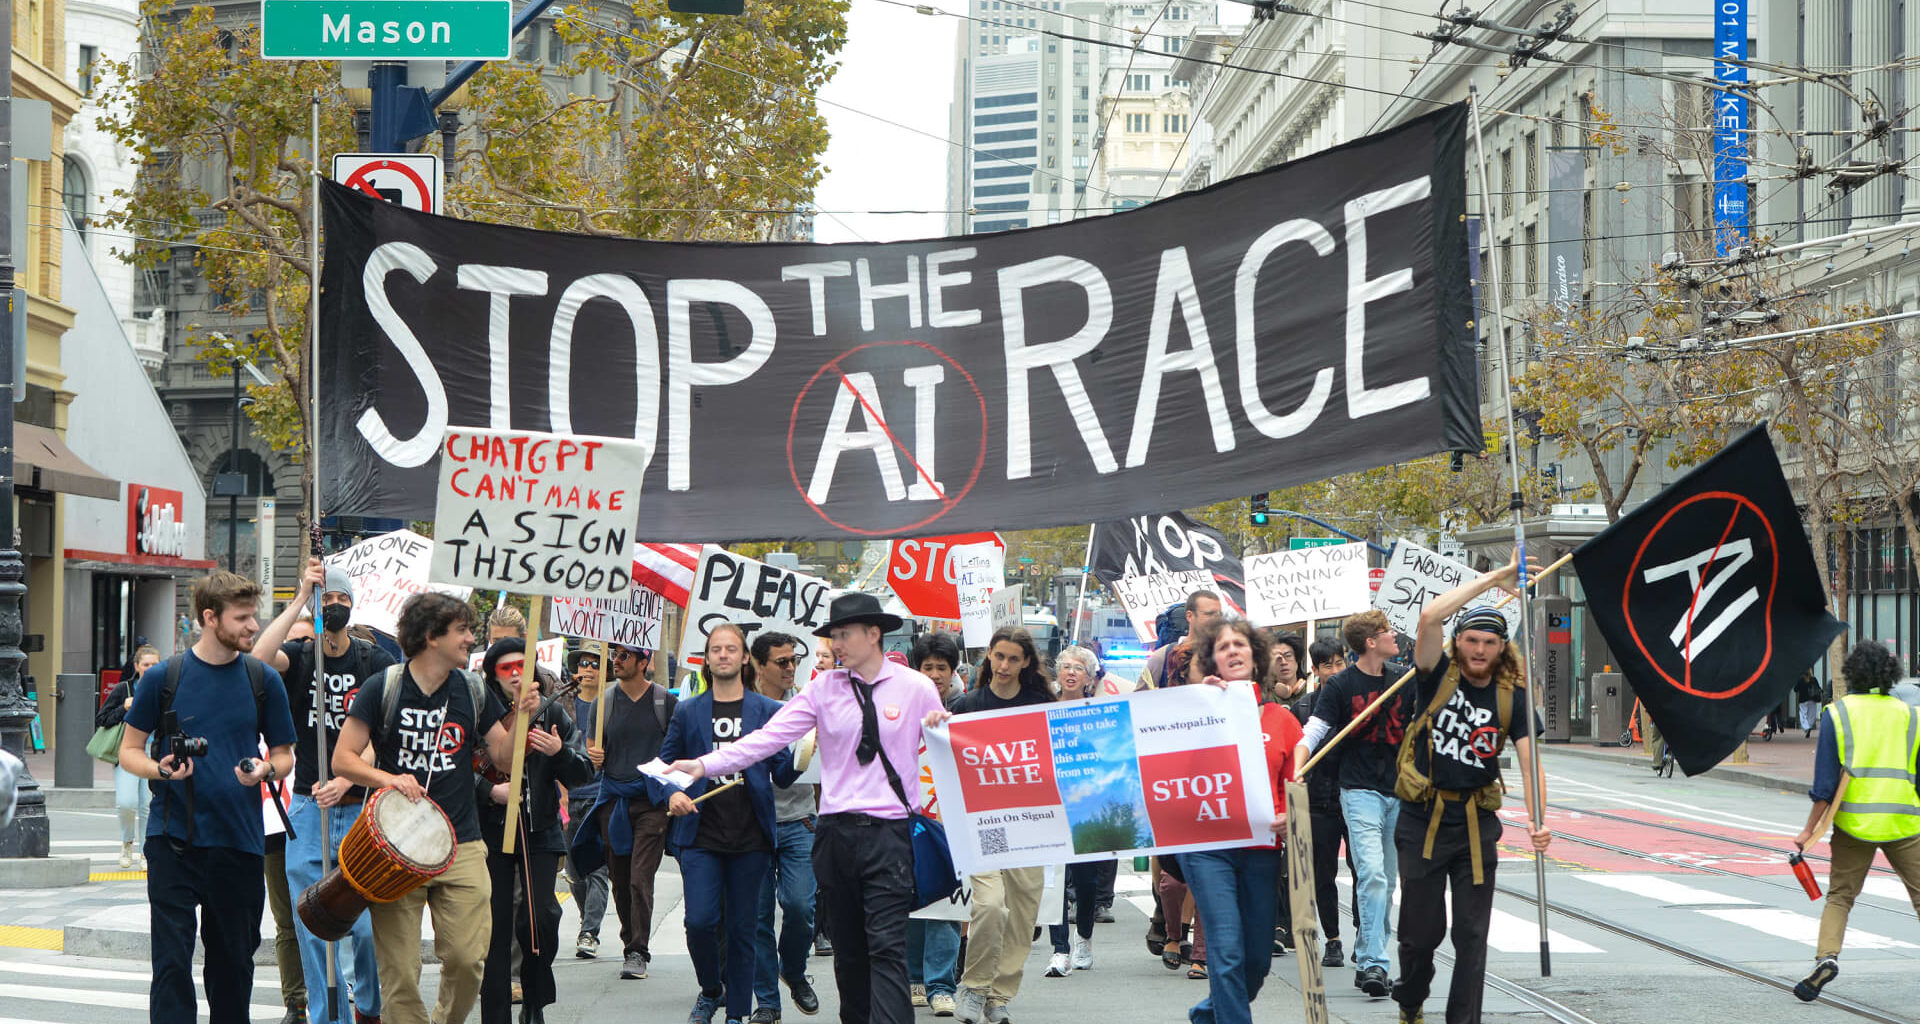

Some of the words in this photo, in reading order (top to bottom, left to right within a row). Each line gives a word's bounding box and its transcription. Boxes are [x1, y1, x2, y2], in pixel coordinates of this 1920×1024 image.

[322, 13, 451, 44] Mason
[356, 241, 776, 492] STOP
[782, 247, 983, 336] THE
[997, 175, 1432, 480] RACE
[806, 365, 944, 505] AI
[446, 433, 603, 474] CHATGPT
[450, 468, 540, 503] CAN'T
[544, 485, 625, 511] MAKE
[462, 508, 489, 538] A
[509, 510, 626, 556] SIGN
[347, 543, 374, 568] NO
[378, 536, 428, 559] ONE
[1251, 549, 1313, 571] MAY
[1320, 544, 1365, 563] YOUR
[262, 557, 270, 585] Powell
[384, 556, 409, 575] IT
[444, 539, 538, 584] THIS
[543, 555, 630, 593] GOOD
[1247, 566, 1346, 591] TRAINING
[1402, 547, 1462, 588] ENOUGH
[699, 553, 830, 628] PLEASE
[962, 572, 974, 586] AI
[1147, 571, 1211, 589] ANYONE
[1125, 587, 1190, 611] BUILDS
[1260, 585, 1323, 601] RUNS
[1643, 537, 1760, 664] AI
[1271, 598, 1341, 618] FAIL
[612, 615, 656, 648] WORK
[1549, 650, 1557, 690] POWELL
[308, 710, 346, 732] RAC
[1104, 704, 1120, 714] are
[1549, 694, 1557, 732] STREET
[1051, 723, 1082, 737] trying
[1082, 722, 1094, 731] to
[1096, 718, 1118, 730] take
[1139, 714, 1227, 735] www.stopai.live
[961, 738, 1040, 767] SAVE
[1053, 738, 1066, 750] all
[1067, 735, 1079, 748] of
[397, 748, 457, 772] RACE
[1055, 752, 1074, 765] this
[976, 763, 1044, 787] LIFE
[1056, 767, 1081, 779] from
[1152, 772, 1234, 802] STOP
[977, 815, 1001, 826] Join
[1003, 813, 1019, 823] On
[1021, 810, 1055, 822] Signal
[1195, 797, 1232, 822] AI
